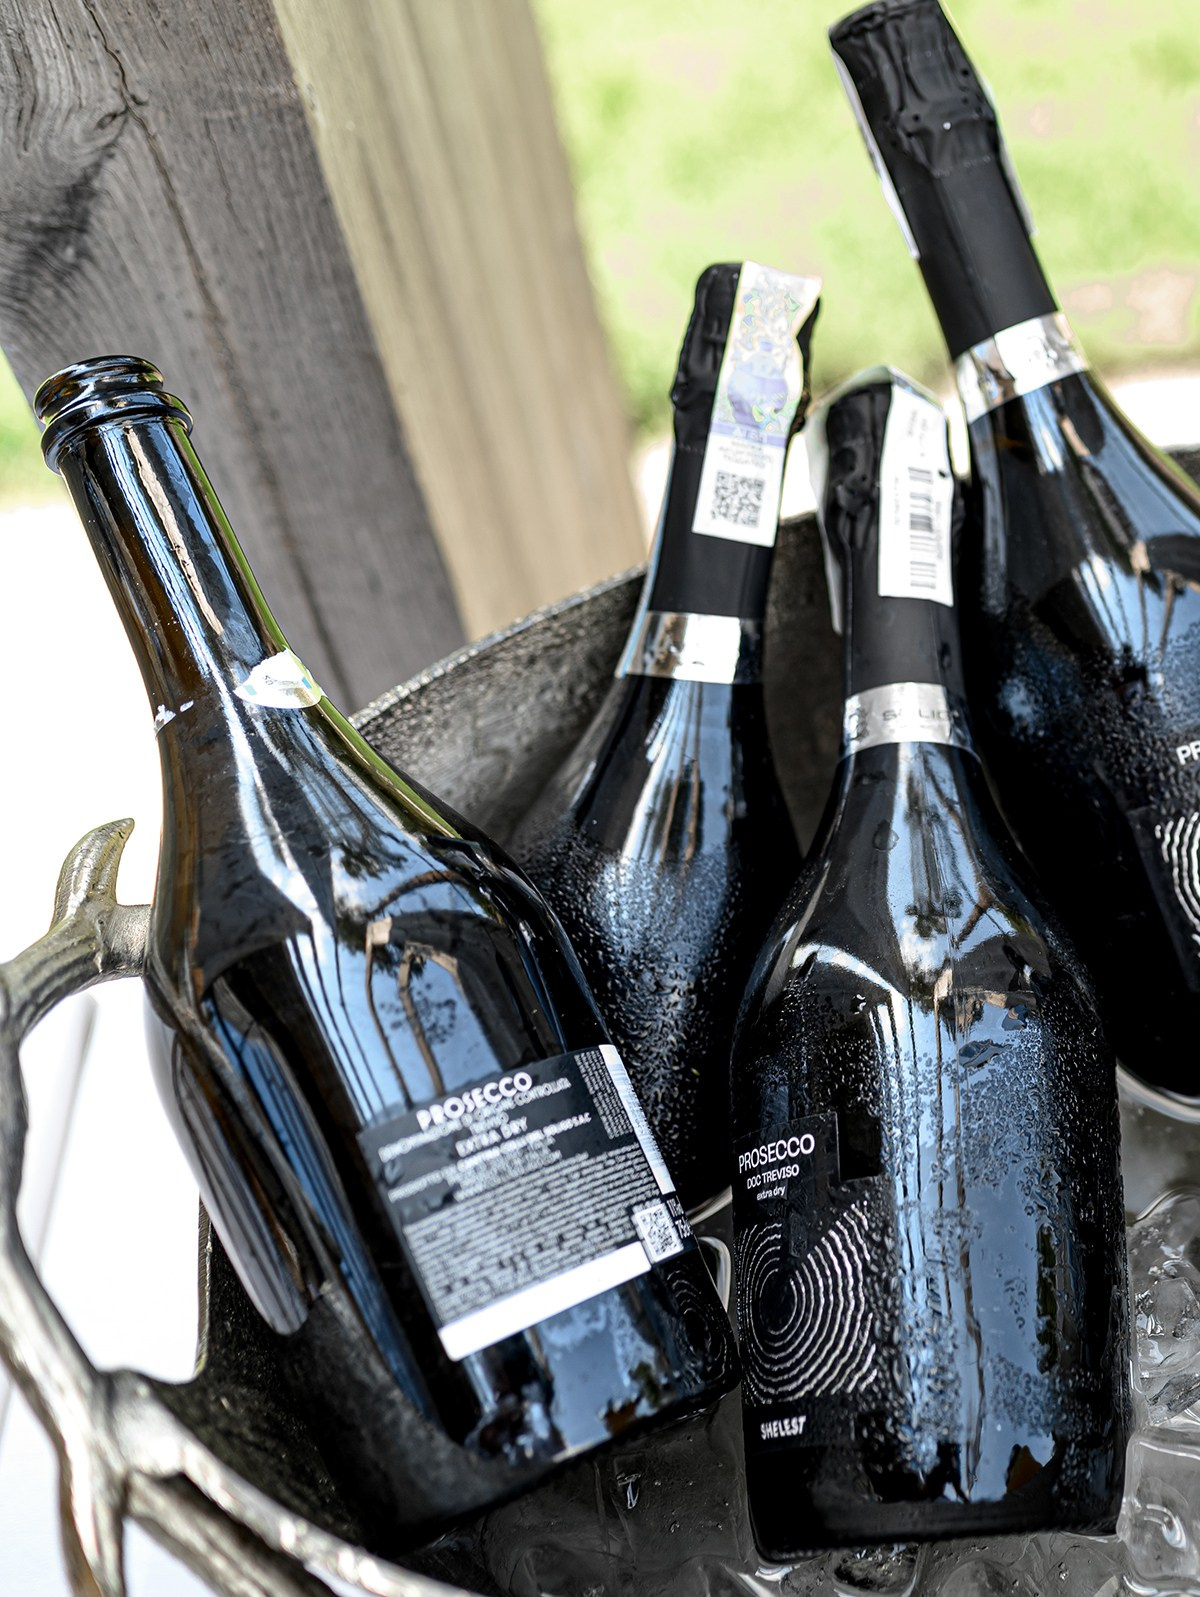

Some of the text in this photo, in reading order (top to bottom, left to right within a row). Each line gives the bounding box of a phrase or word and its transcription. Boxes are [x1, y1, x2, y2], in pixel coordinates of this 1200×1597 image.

[416, 1072, 533, 1131] PROSECCO
[738, 1133, 815, 1174] PROSECCO
[747, 1163, 800, 1189] DOC TREVISO
[756, 1185, 786, 1201] extra dry
[760, 1415, 807, 1441] SHELEST
